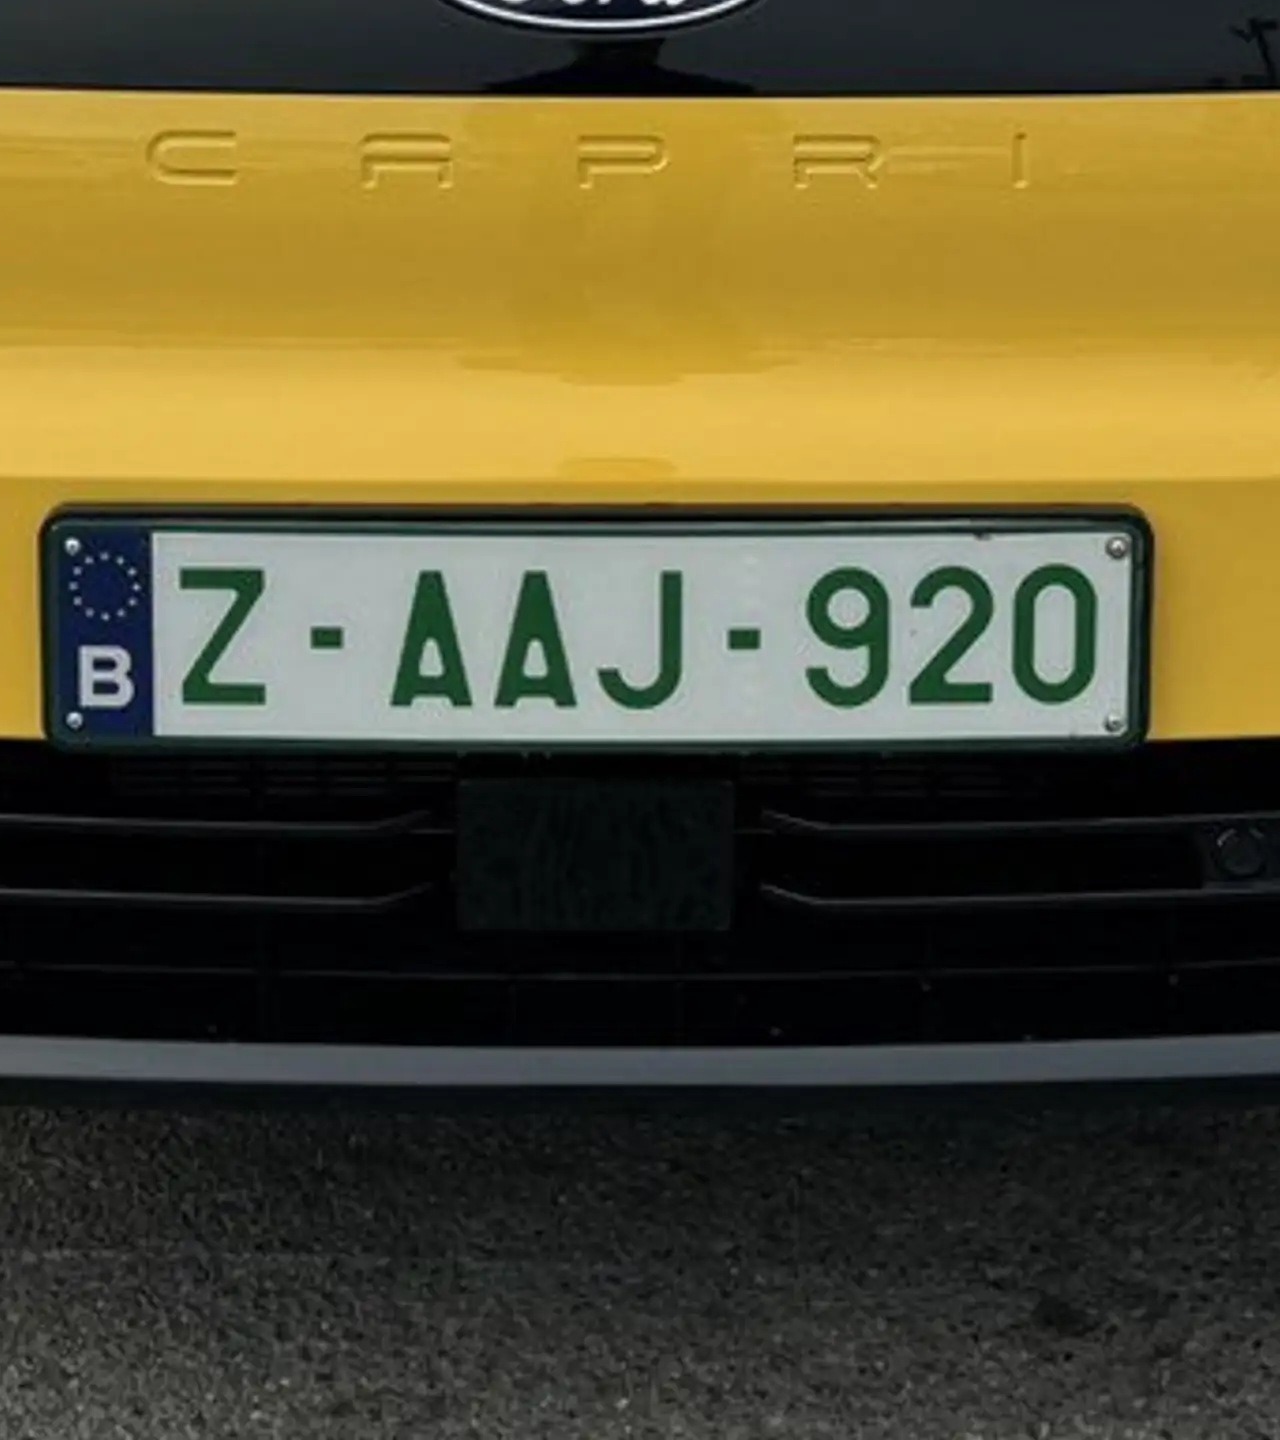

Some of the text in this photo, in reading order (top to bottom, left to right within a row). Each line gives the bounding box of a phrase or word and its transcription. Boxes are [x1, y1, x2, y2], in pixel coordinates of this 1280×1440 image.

[145, 129, 1029, 189] CAPRI
[178, 564, 1098, 709] Z-AAJ-920
[77, 646, 135, 708] B
